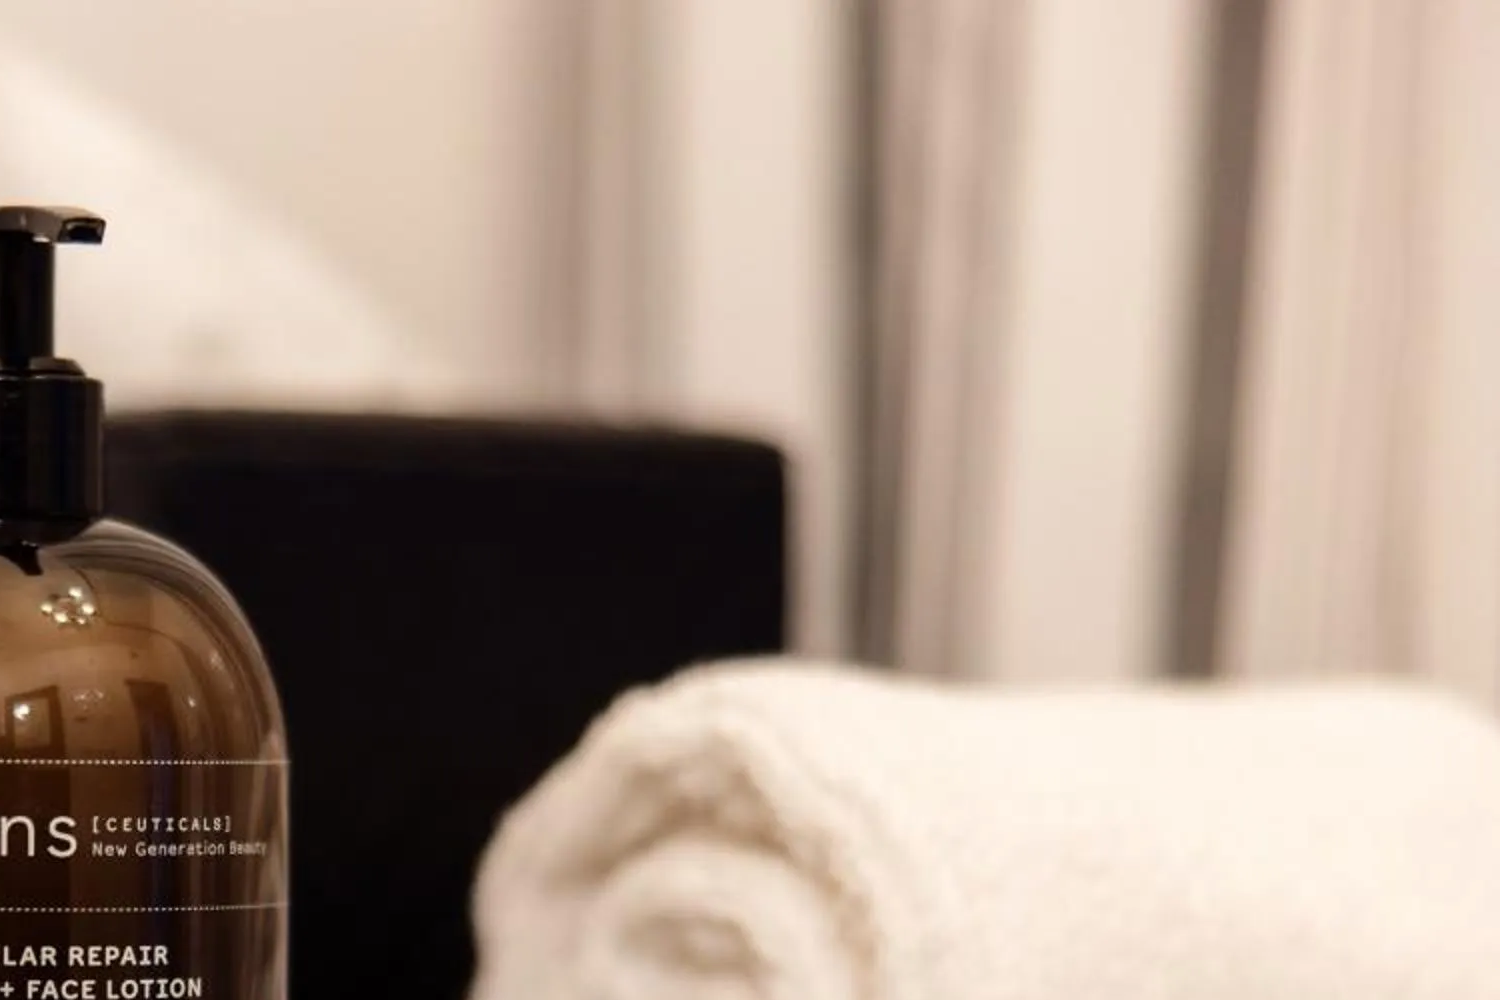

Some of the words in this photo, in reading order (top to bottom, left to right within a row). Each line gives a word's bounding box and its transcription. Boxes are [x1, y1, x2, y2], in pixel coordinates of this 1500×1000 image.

[92, 816, 232, 834] [CEUTICALS]
[92, 842, 128, 857] New
[135, 841, 225, 857] Generation
[69, 947, 169, 966] REPAIR
[27, 980, 96, 1000] FACE
[106, 976, 202, 999] LOTION
